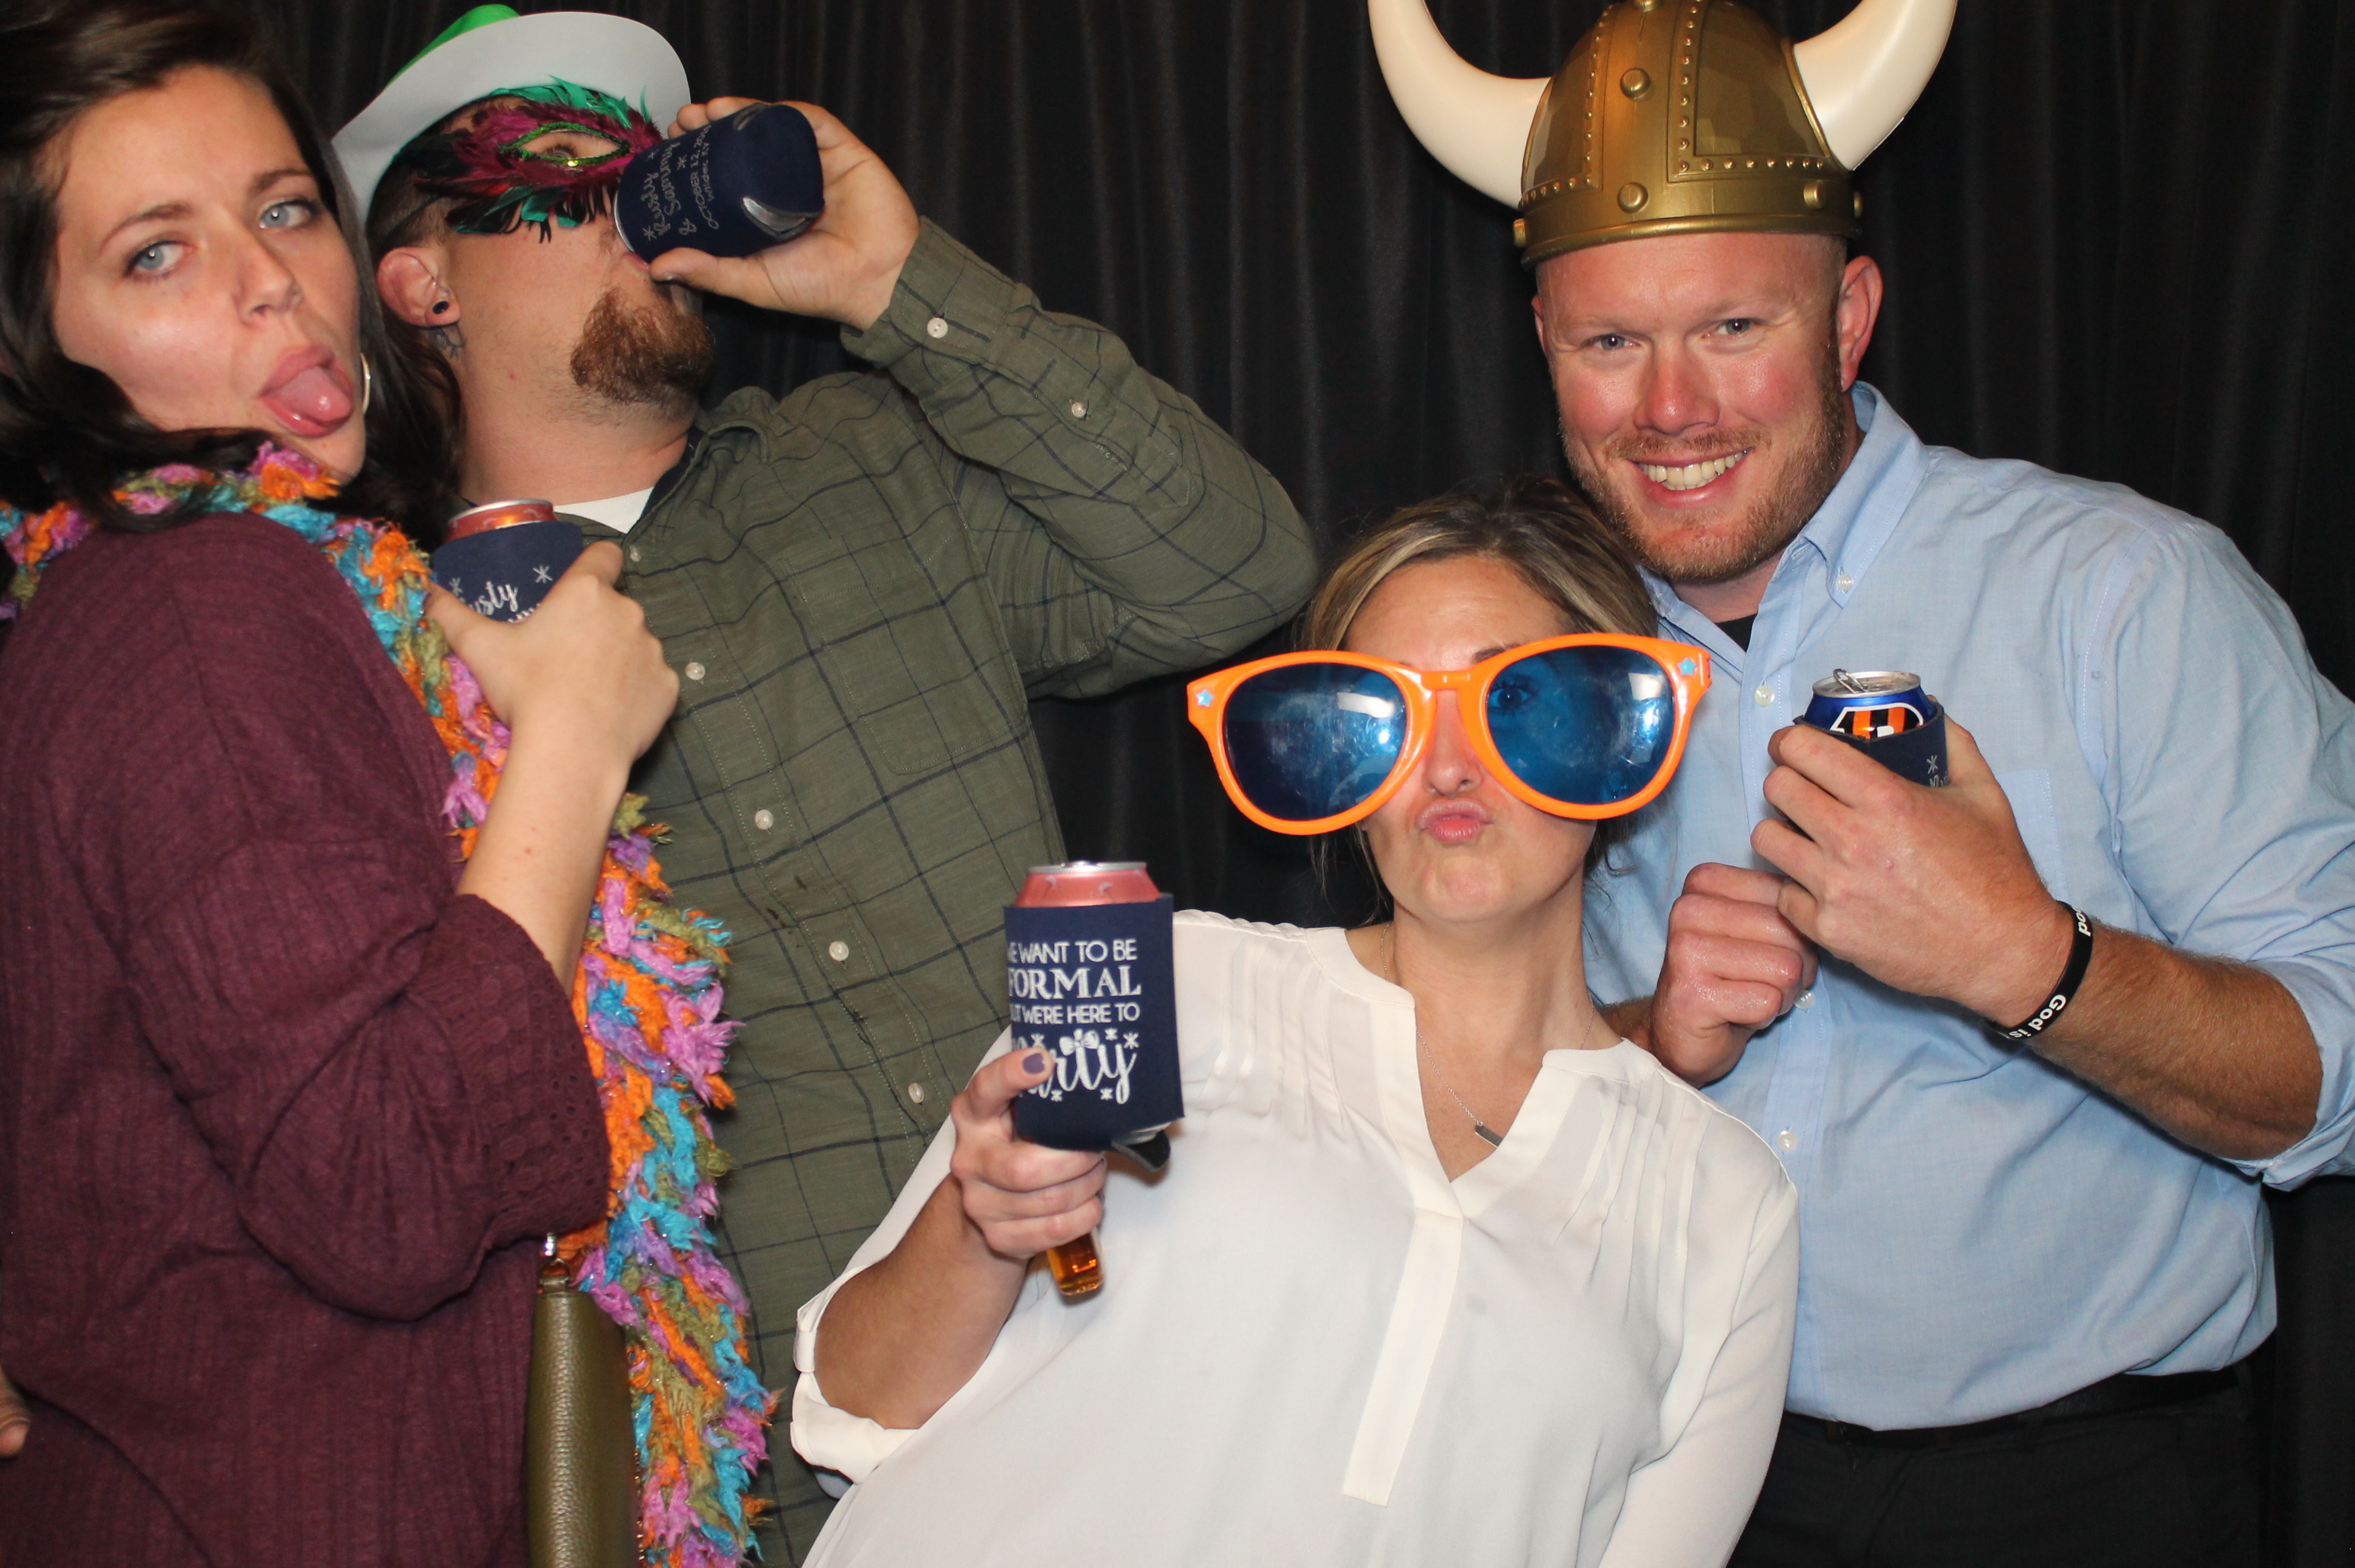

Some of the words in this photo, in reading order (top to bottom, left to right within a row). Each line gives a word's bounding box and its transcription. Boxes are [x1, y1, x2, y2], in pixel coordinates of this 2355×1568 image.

[690, 171, 719, 230] OCTOBER
[678, 217, 697, 236] &
[1017, 940, 1070, 965] WANT
[1074, 939, 1109, 963] TO
[1113, 937, 1139, 962] BE
[1066, 1002, 1113, 1024] HERE
[1114, 1001, 1141, 1022] TO
[2028, 994, 2067, 1031] God
[2009, 1028, 2032, 1038] is
[1011, 1029, 1138, 1104] rty
